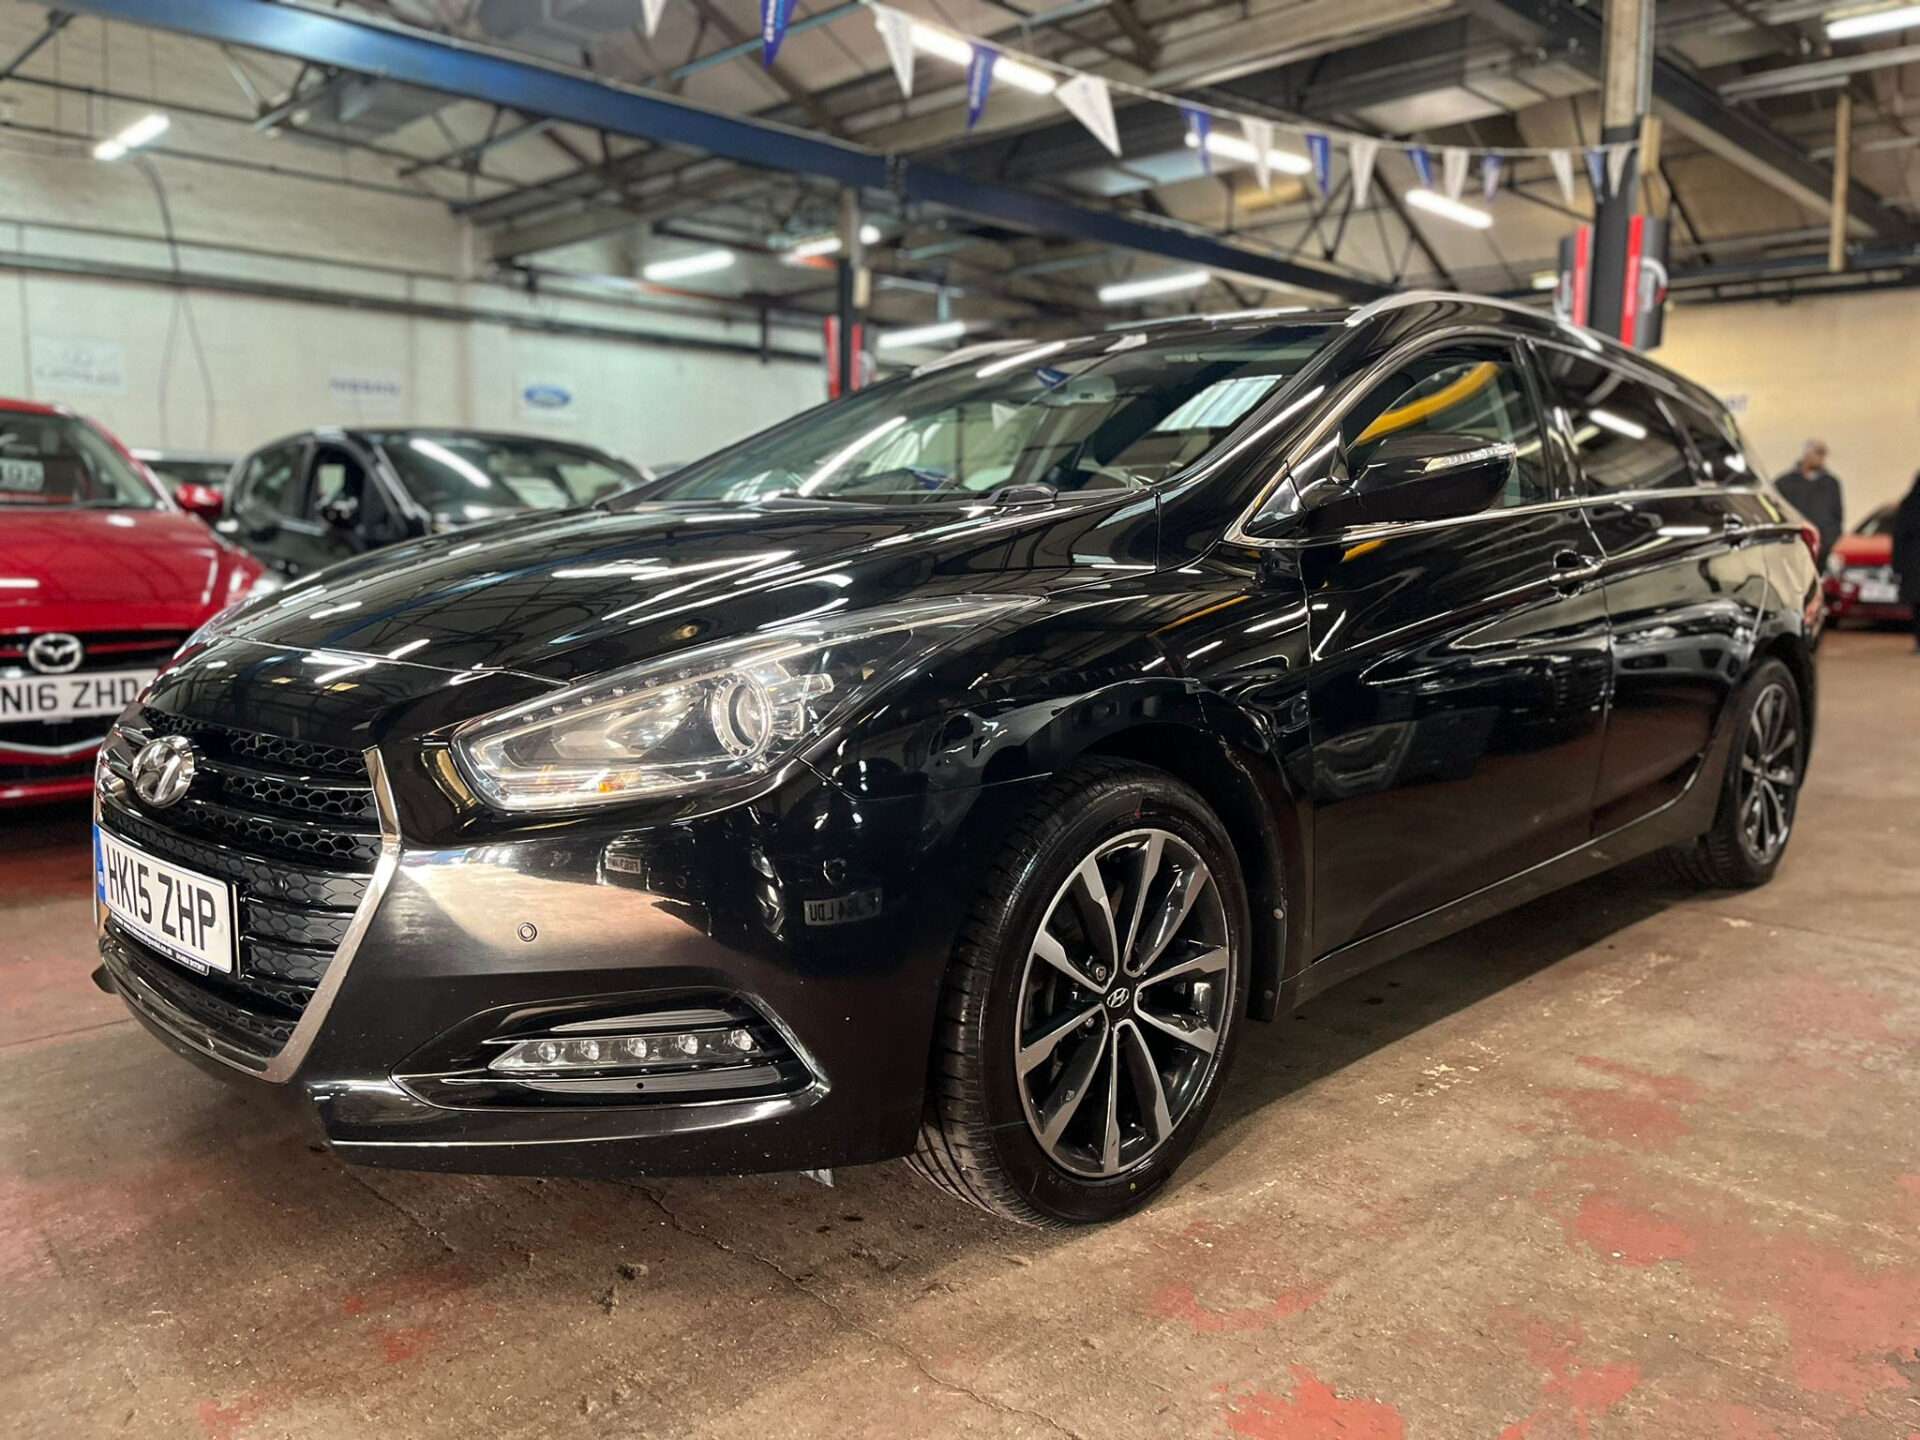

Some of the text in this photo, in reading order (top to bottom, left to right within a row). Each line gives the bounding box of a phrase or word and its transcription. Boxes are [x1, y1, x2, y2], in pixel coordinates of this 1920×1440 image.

[0, 682, 58, 714] N16
[106, 844, 153, 925] HK15
[158, 871, 216, 951] ZHP
